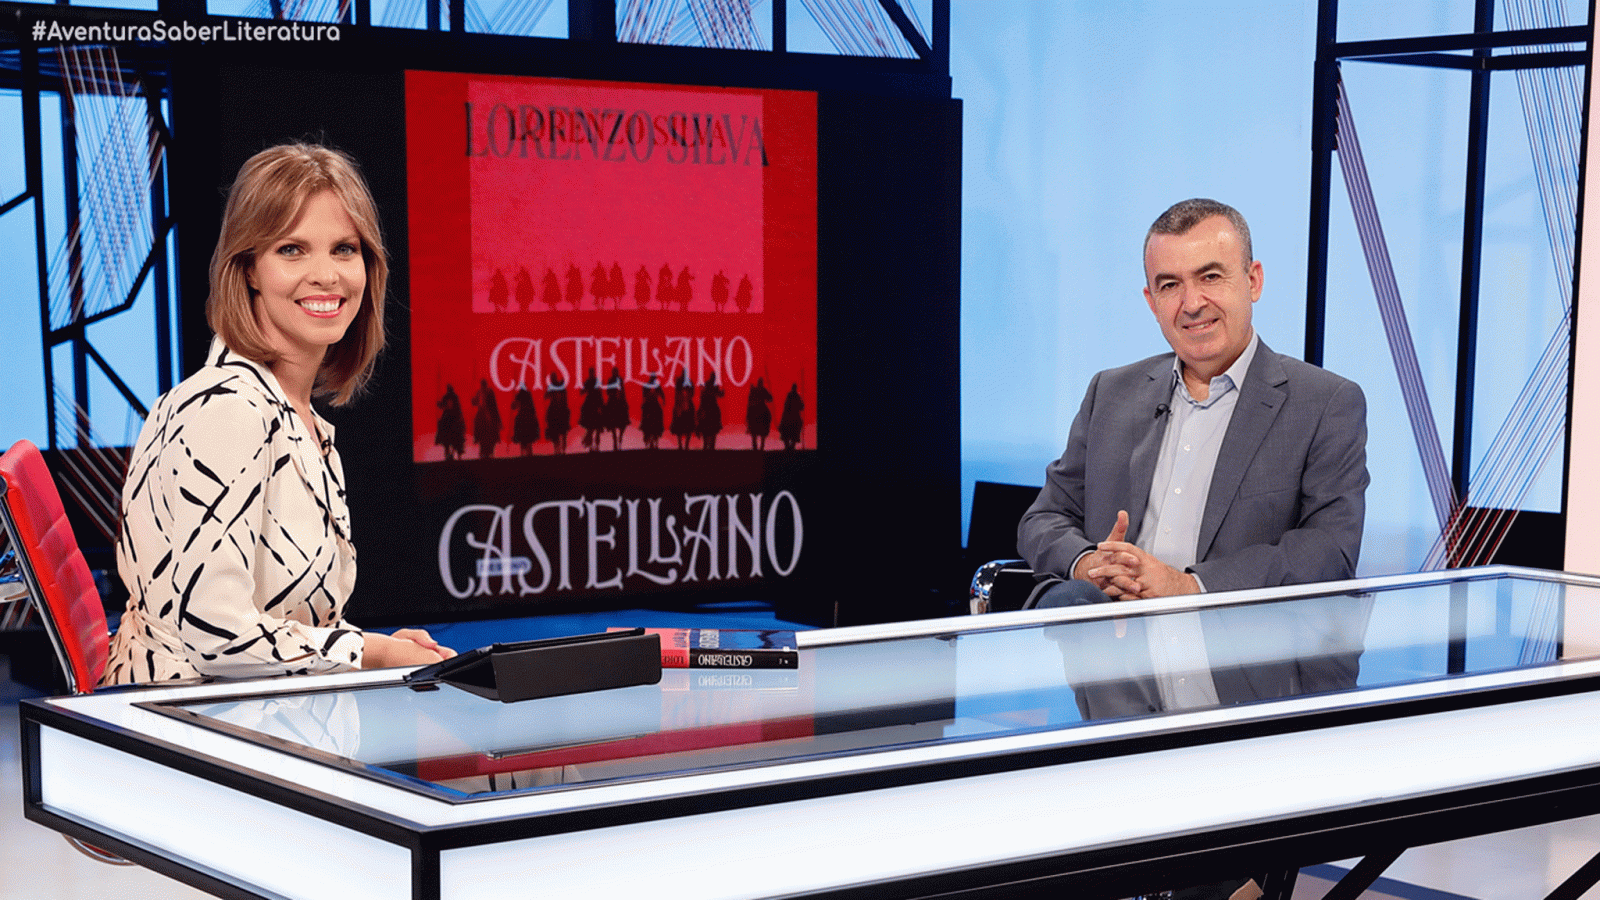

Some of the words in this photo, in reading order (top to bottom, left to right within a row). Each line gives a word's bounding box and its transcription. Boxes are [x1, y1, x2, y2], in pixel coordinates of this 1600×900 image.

[464, 102, 655, 163] LORENZO
[667, 111, 769, 166] SILVA
[508, 110, 645, 145] LORENZO
[652, 115, 727, 147] SILVA
[489, 335, 753, 392] CASTELLANO
[438, 490, 803, 599] CASTELLANO
[698, 653, 753, 666] CASTELLANO
